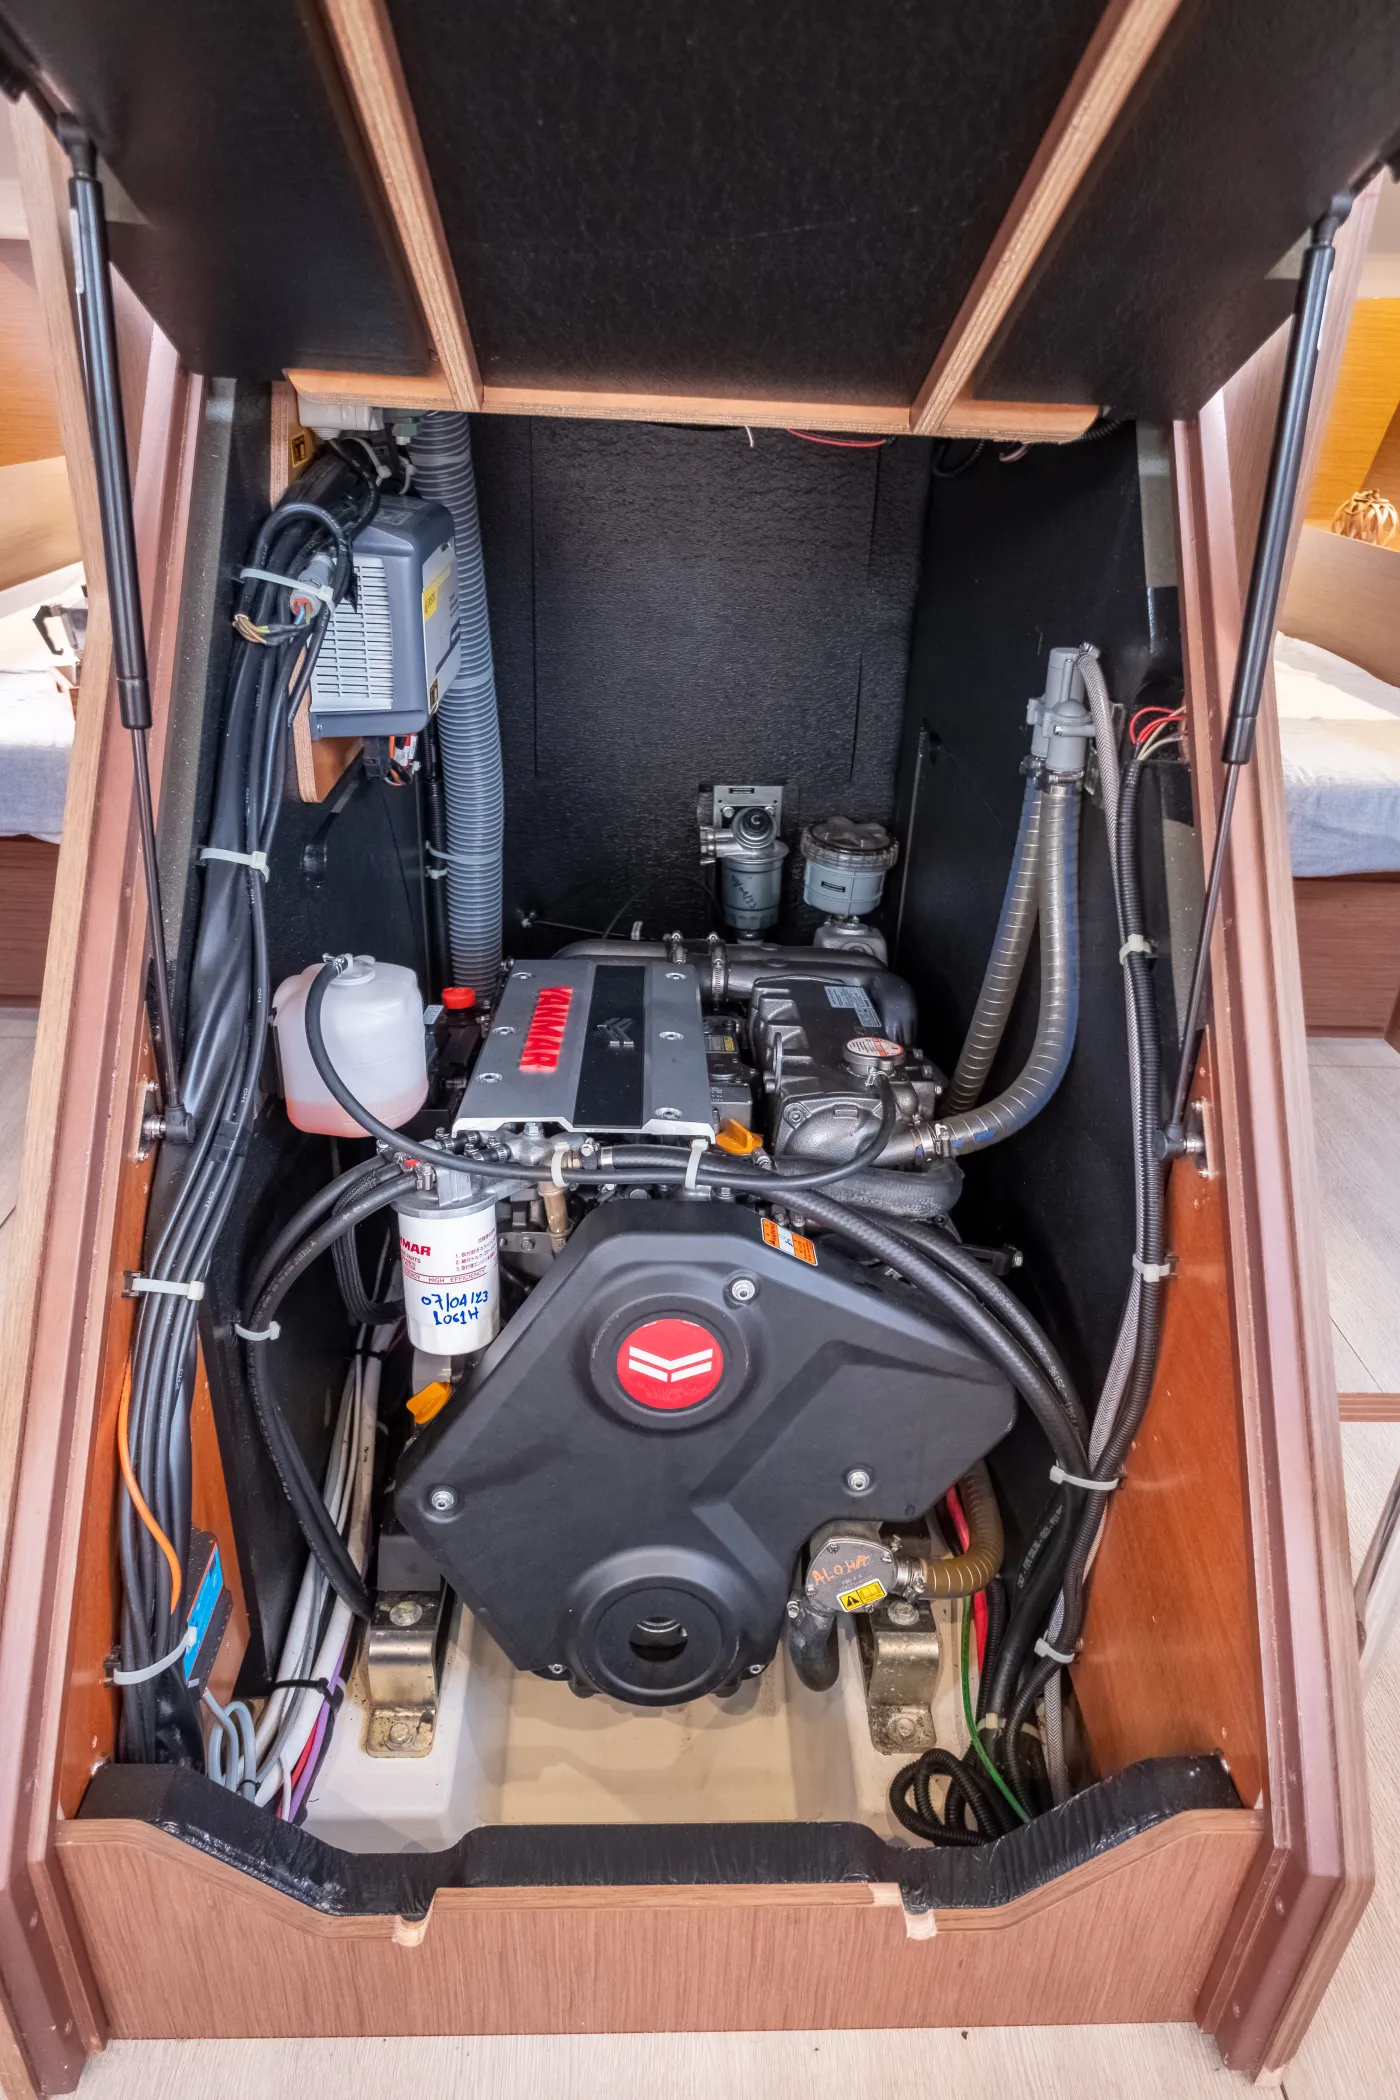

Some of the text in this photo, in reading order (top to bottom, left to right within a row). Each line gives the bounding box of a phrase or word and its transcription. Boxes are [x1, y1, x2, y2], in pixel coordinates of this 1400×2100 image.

[519, 985, 574, 1073] YANMAR
[449, 1269, 487, 1283] EFFICIENCY
[1048, 1364, 1066, 1390] 25196
